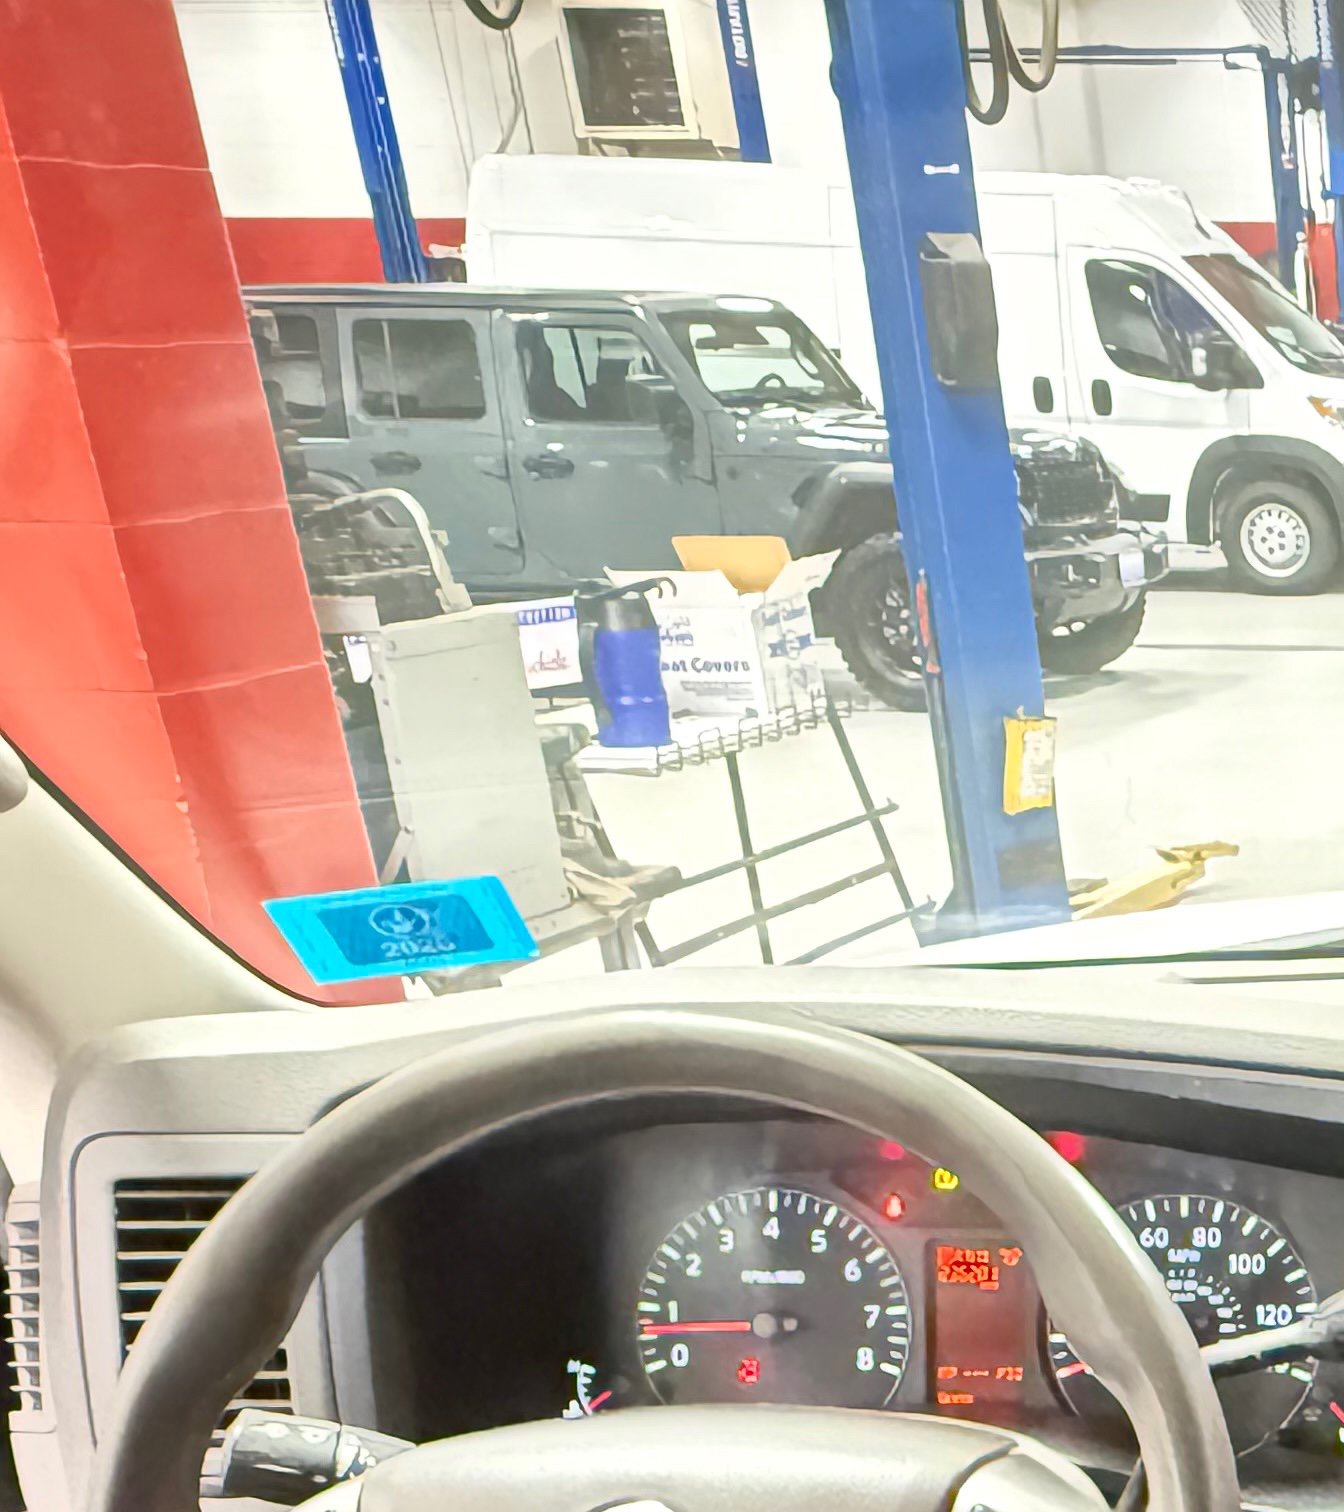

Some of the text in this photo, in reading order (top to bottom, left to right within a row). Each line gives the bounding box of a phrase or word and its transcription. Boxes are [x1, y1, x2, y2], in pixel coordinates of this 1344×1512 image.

[718, 1227, 735, 1253] 3
[762, 1216, 781, 1240] 4
[1139, 1226, 1169, 1249] 60
[1191, 1226, 1222, 1249] 80
[810, 1228, 828, 1254] 5
[685, 1252, 703, 1278] 2
[844, 1257, 863, 1282] 6
[1227, 1253, 1266, 1276] 100
[667, 1299, 679, 1323] 1
[863, 1304, 880, 1329] 7
[1255, 1303, 1293, 1327] 120
[670, 1342, 690, 1368] 0
[855, 1346, 875, 1372] 8
